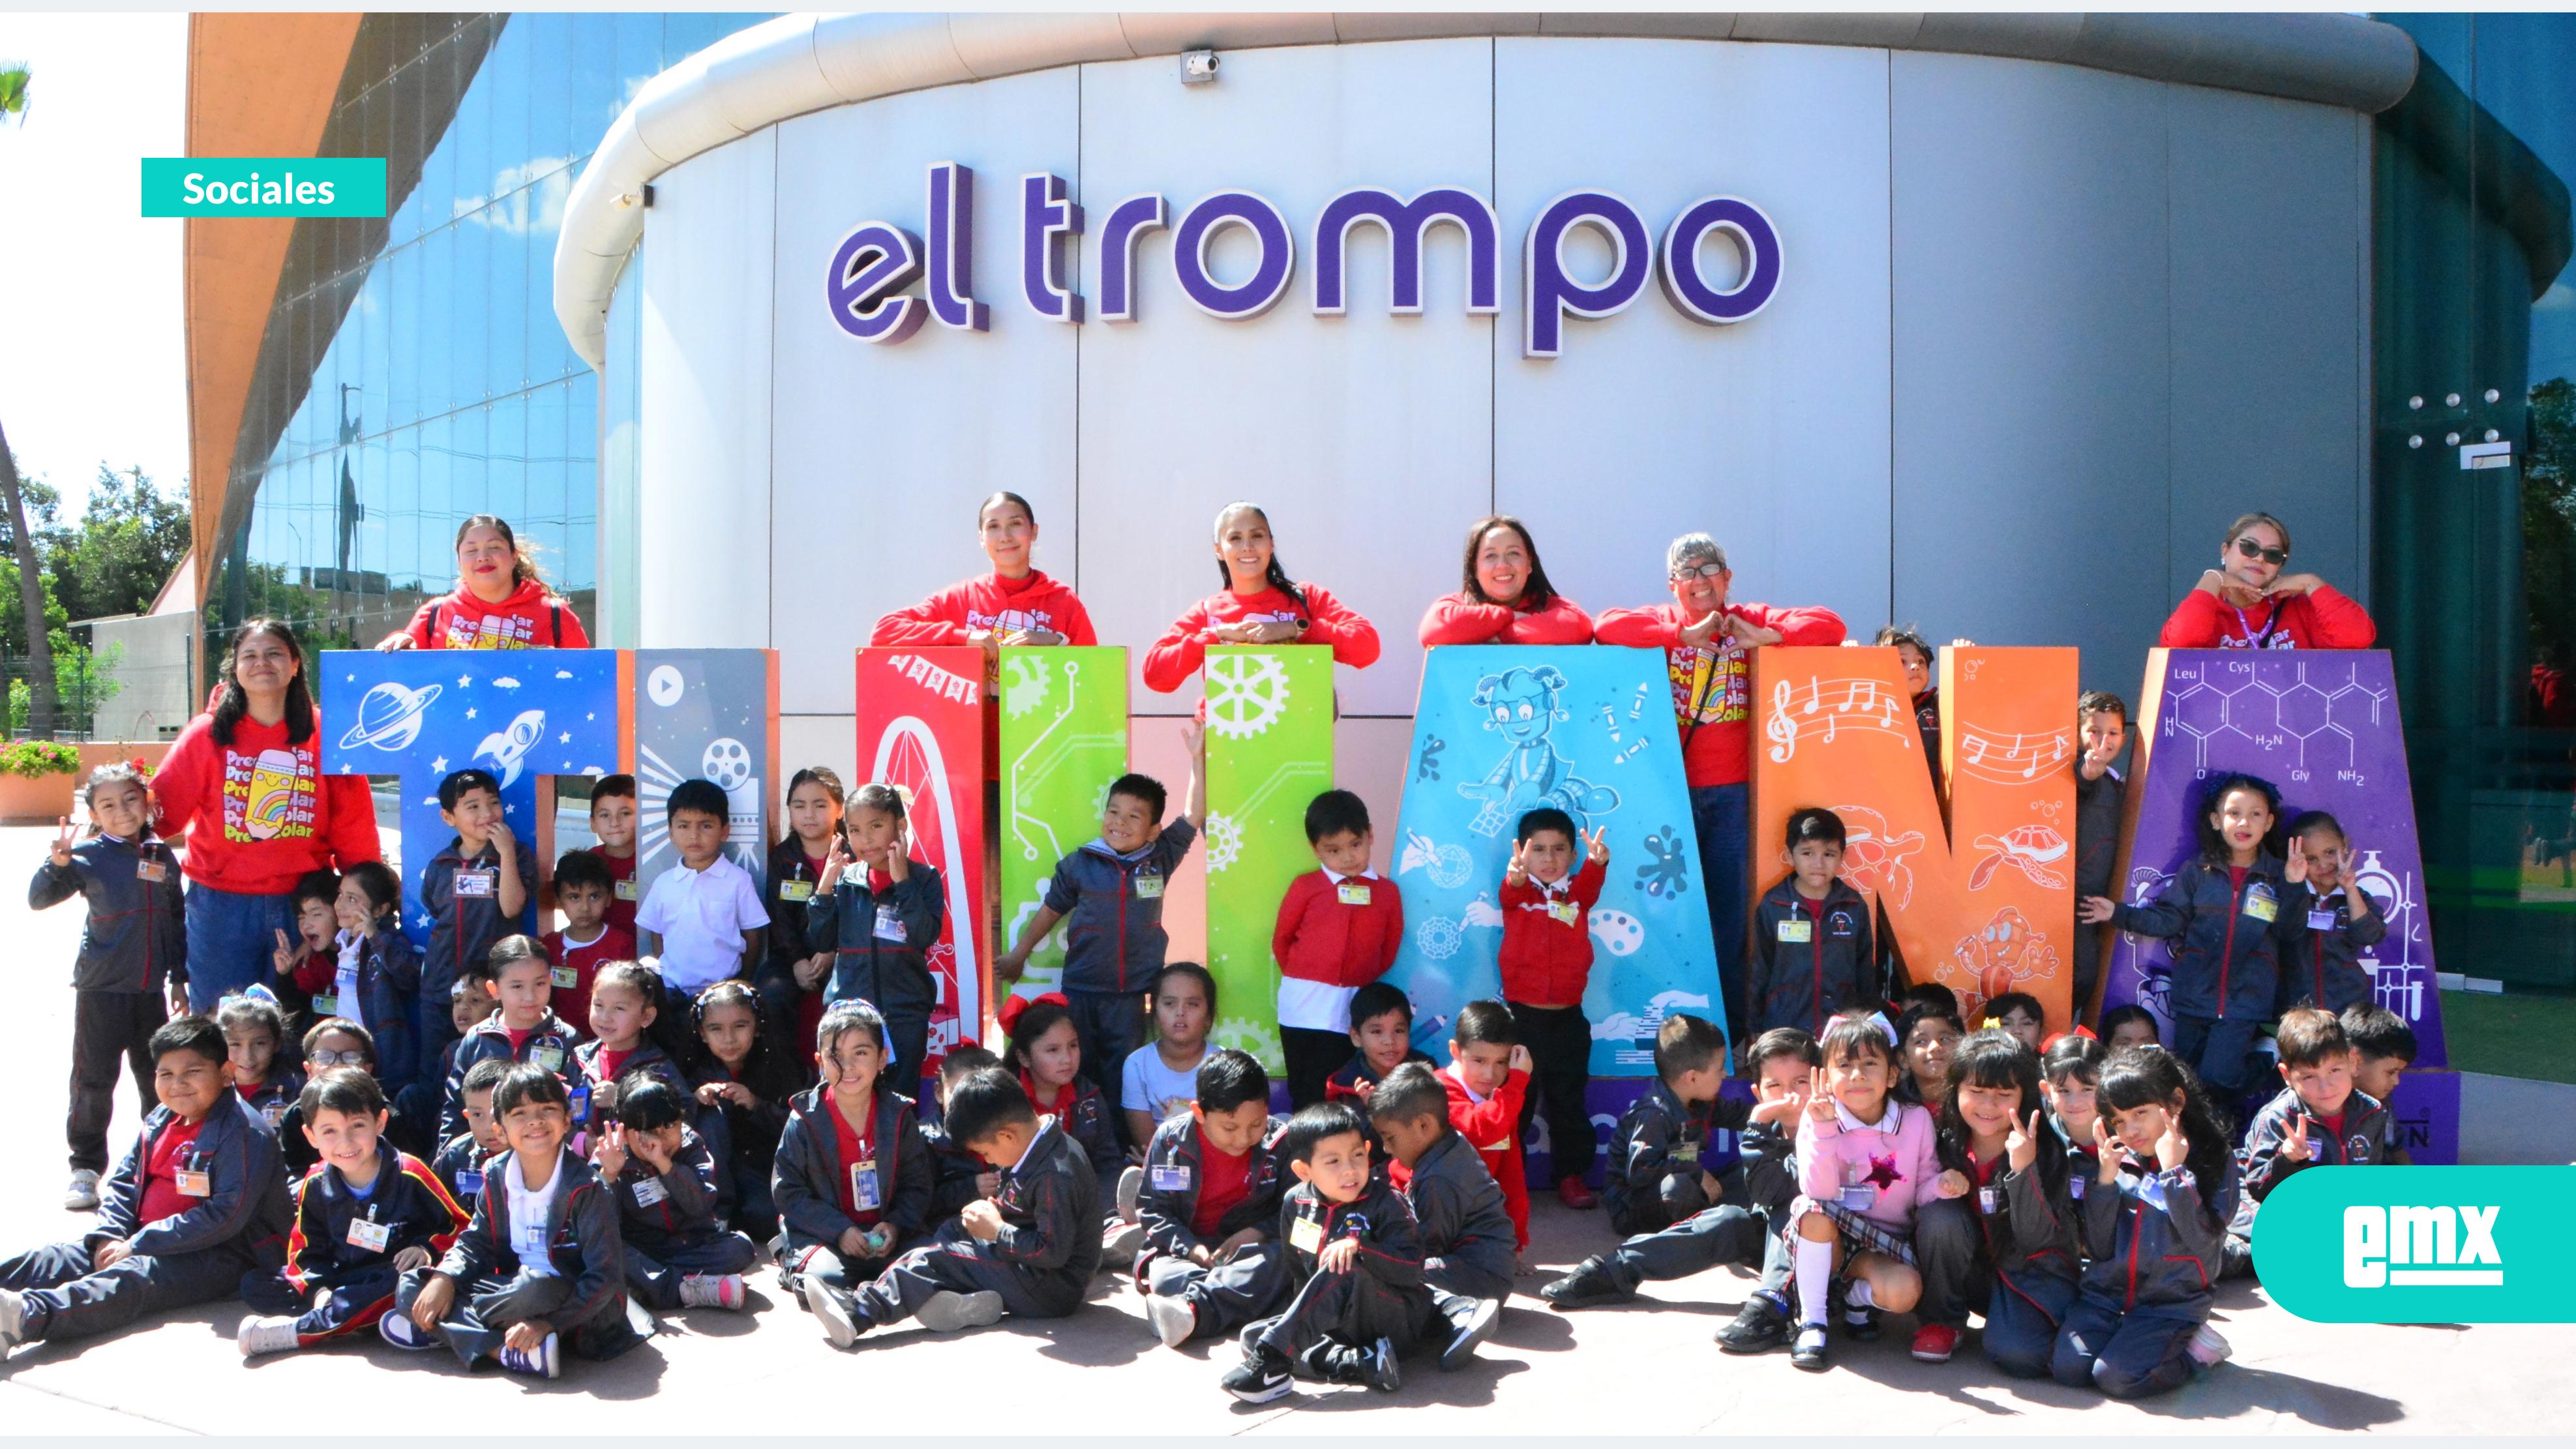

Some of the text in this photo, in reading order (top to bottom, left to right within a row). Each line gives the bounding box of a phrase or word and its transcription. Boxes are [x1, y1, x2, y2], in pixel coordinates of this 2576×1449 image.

[826, 160, 1785, 359] el trompo
[2229, 661, 2250, 673] Cys
[2174, 668, 2197, 680] Leu
[2292, 770, 2310, 783] Gly
